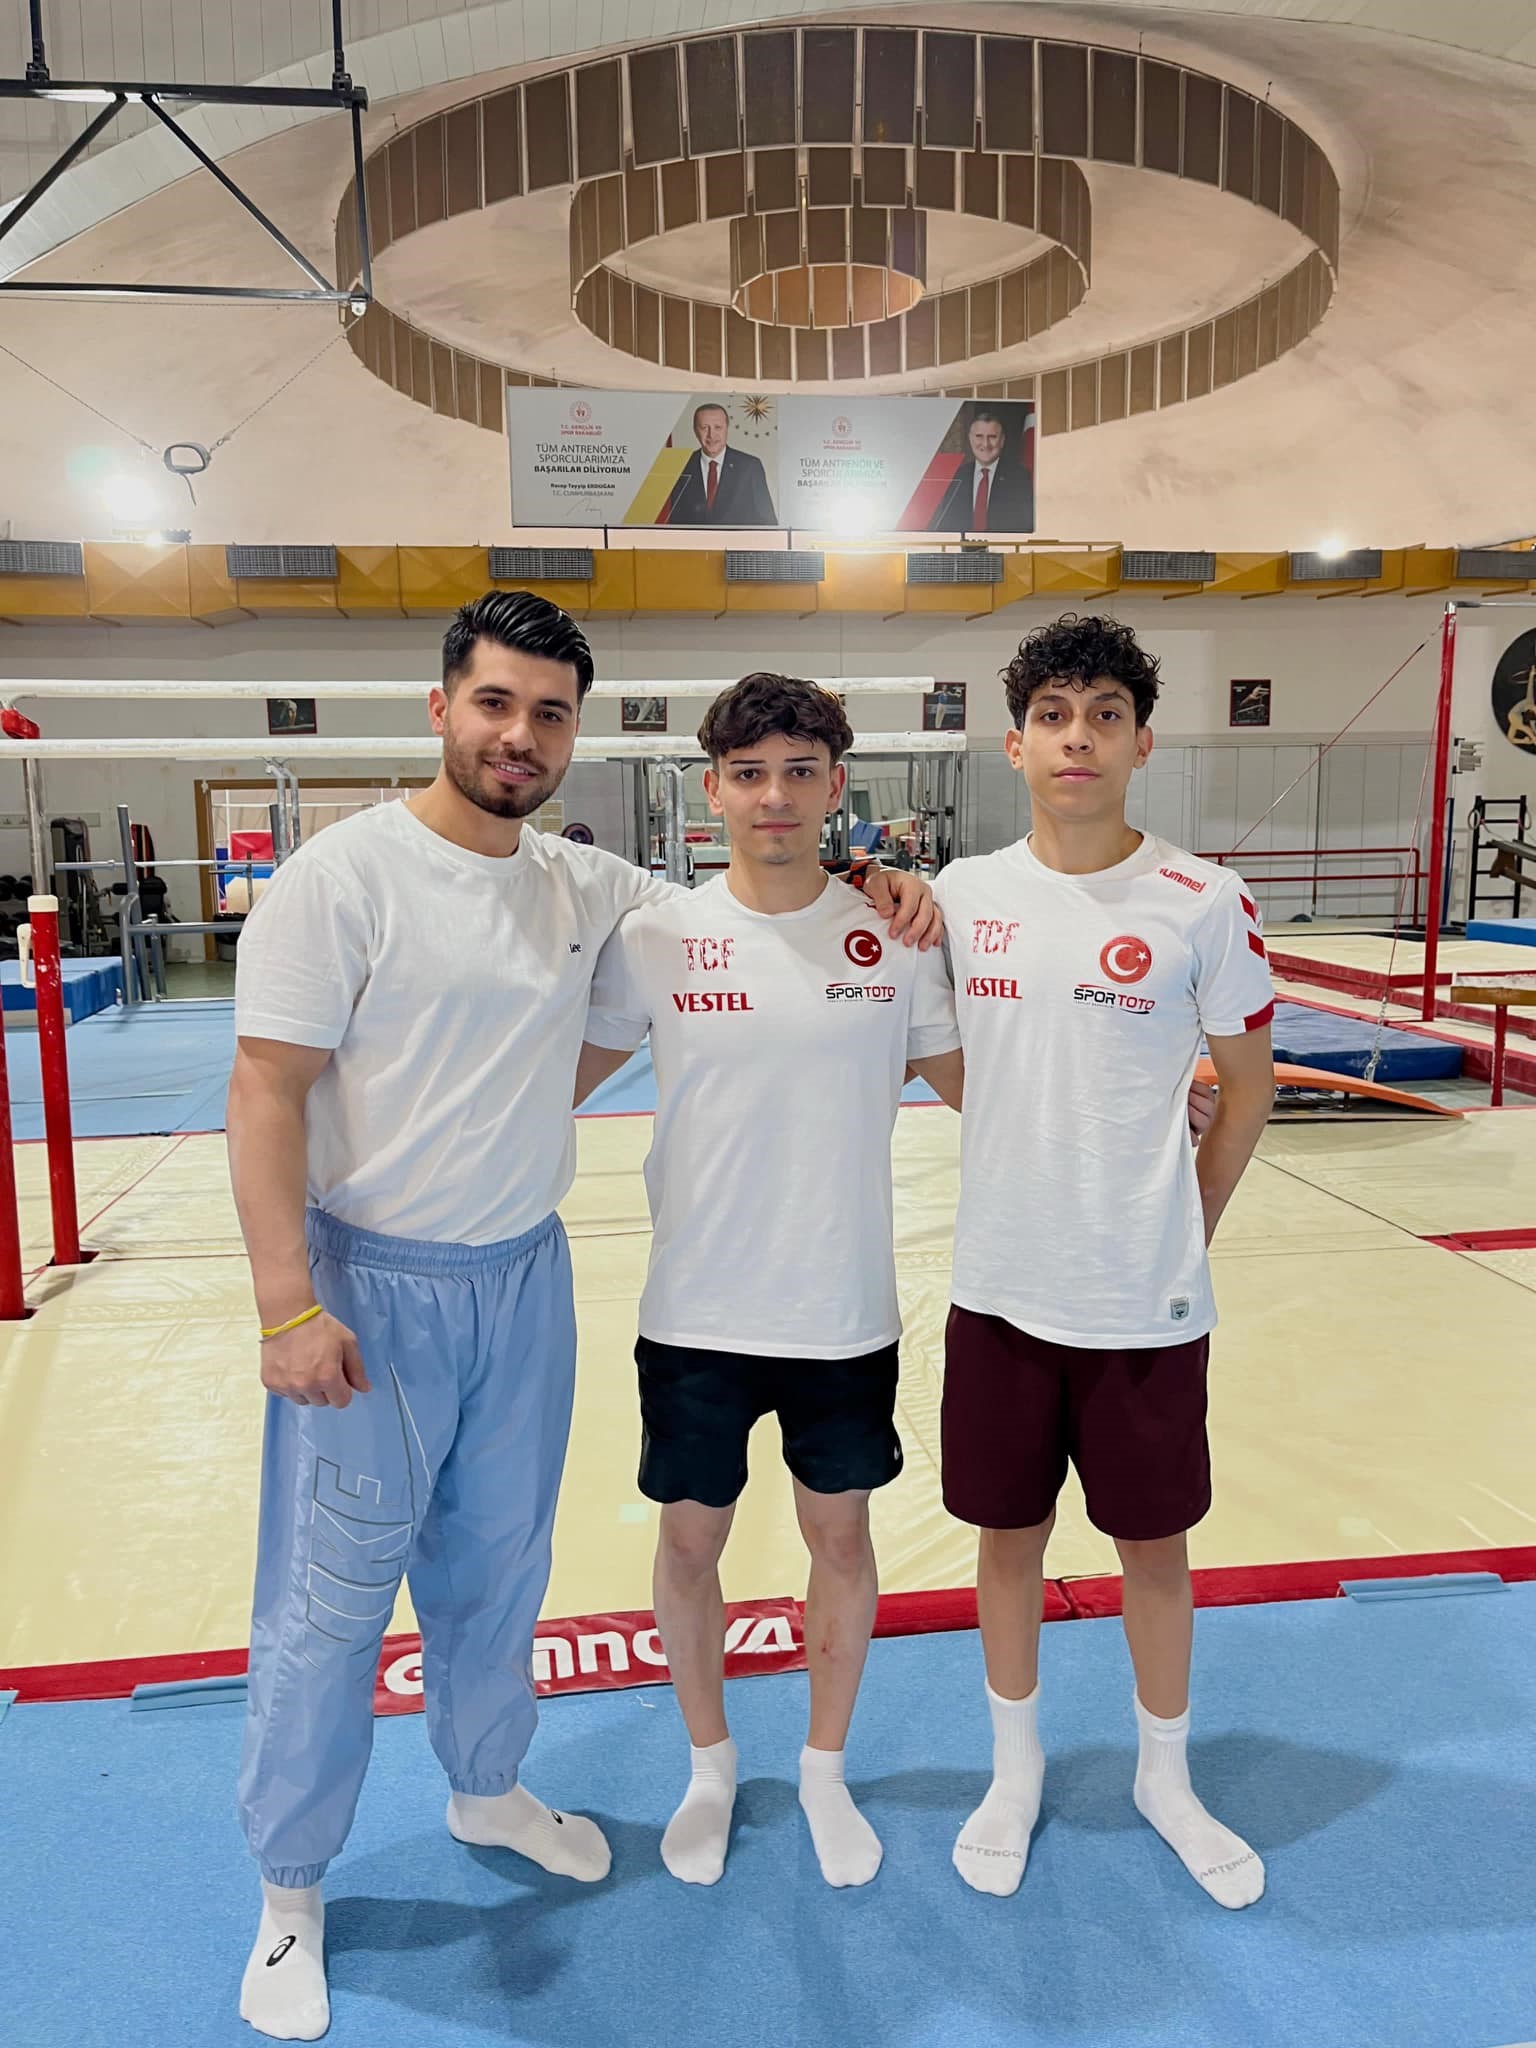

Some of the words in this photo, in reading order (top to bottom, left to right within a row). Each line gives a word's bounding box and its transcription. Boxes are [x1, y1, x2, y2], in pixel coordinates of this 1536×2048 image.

[536, 442, 558, 453] TÜM
[561, 443, 614, 454] ANTRENÖR
[616, 445, 628, 454] VE
[539, 454, 625, 464] SPORCULARIMIZA
[800, 457, 820, 468] TÜM
[534, 465, 581, 474] BAŞARILAR
[583, 465, 631, 474] DİLİYORUM
[973, 919, 1020, 954] TCF
[682, 937, 734, 971] TCF
[966, 976, 1023, 999] VESTEL
[673, 992, 754, 1013] VESTEL
